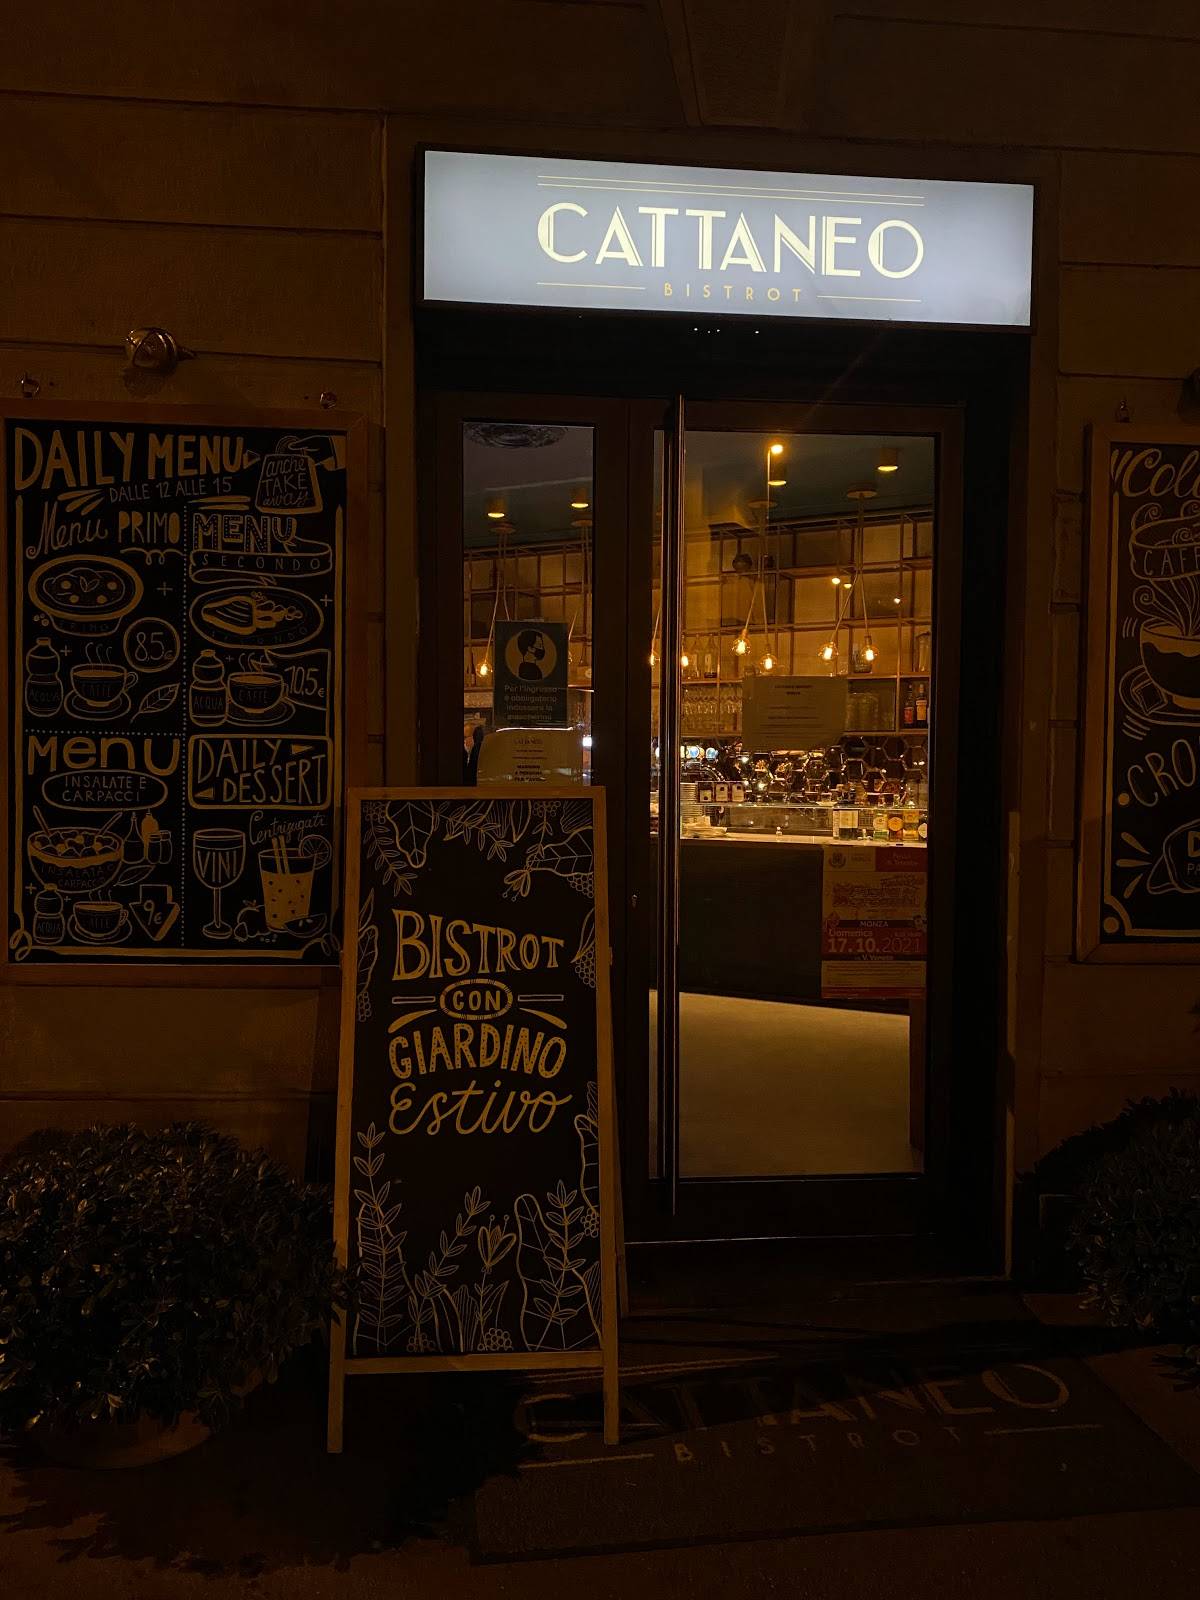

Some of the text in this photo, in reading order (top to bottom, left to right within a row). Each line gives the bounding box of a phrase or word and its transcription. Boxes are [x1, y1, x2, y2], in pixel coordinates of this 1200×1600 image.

[537, 202, 924, 279] CATTANEO
[664, 282, 802, 302] BISTROT
[15, 427, 244, 491] DAILY MENU
[266, 456, 306, 477] anche
[109, 476, 232, 503] DALLE 12 ALLE 15
[262, 473, 307, 496] TAKE
[25, 501, 181, 560] Menu PRIMO
[192, 513, 297, 553] MENU
[201, 553, 321, 570] SECONDO
[198, 739, 282, 784] DAILY
[62, 789, 140, 802] CARPACCI
[64, 775, 147, 790] INSALATE E
[223, 754, 326, 804] DESSERT
[197, 850, 237, 883] VINI
[860, 920, 889, 928] MONZA
[391, 908, 565, 981] BISTROT
[827, 937, 921, 953] 17.10.2021
[452, 990, 501, 1011] CON
[388, 1022, 567, 1079] GIARDINO
[389, 1080, 573, 1135] Estivo
[673, 1425, 962, 1463] BISTROT
